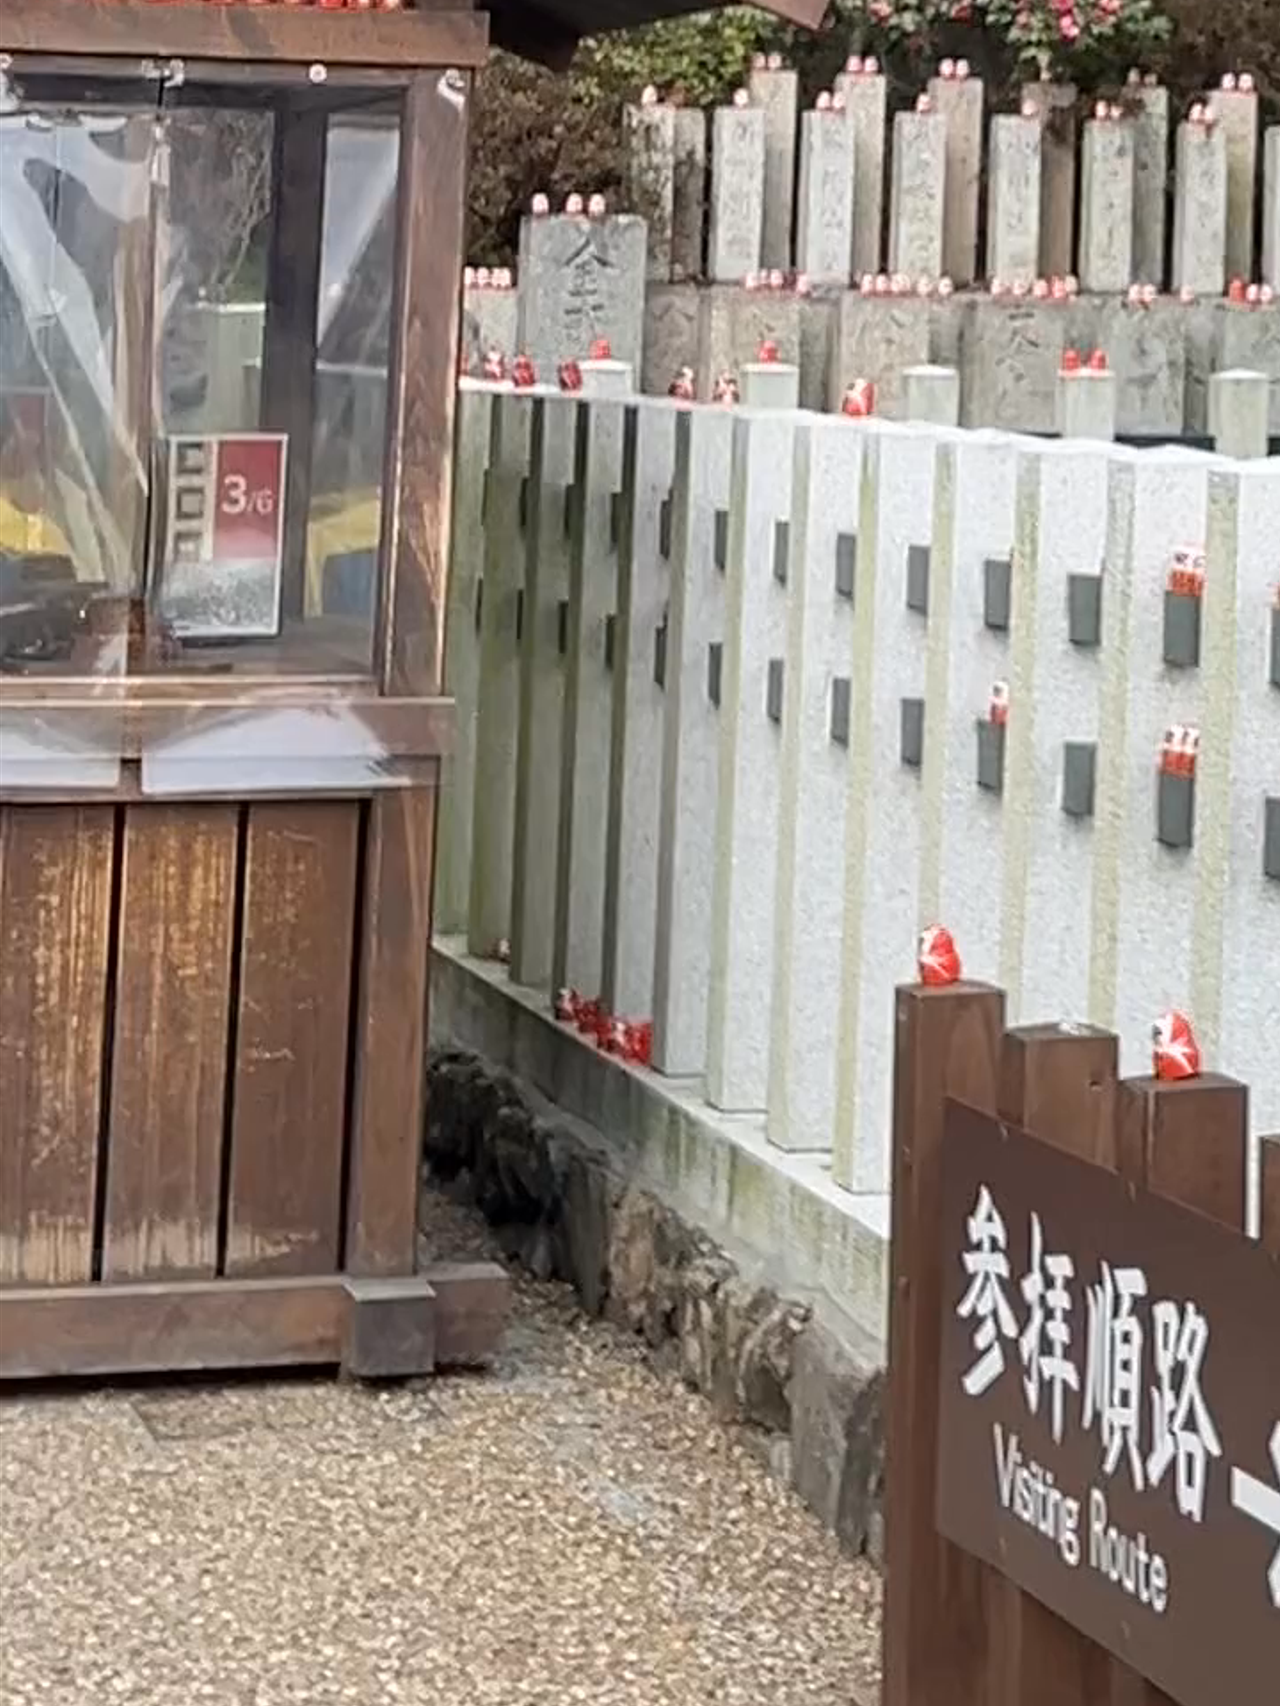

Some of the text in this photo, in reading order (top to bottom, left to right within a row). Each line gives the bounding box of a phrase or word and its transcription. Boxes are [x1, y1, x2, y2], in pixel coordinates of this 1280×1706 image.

[955, 1183, 1223, 1523] 参拝順路
[993, 1422, 1168, 1613] Visiting Route
